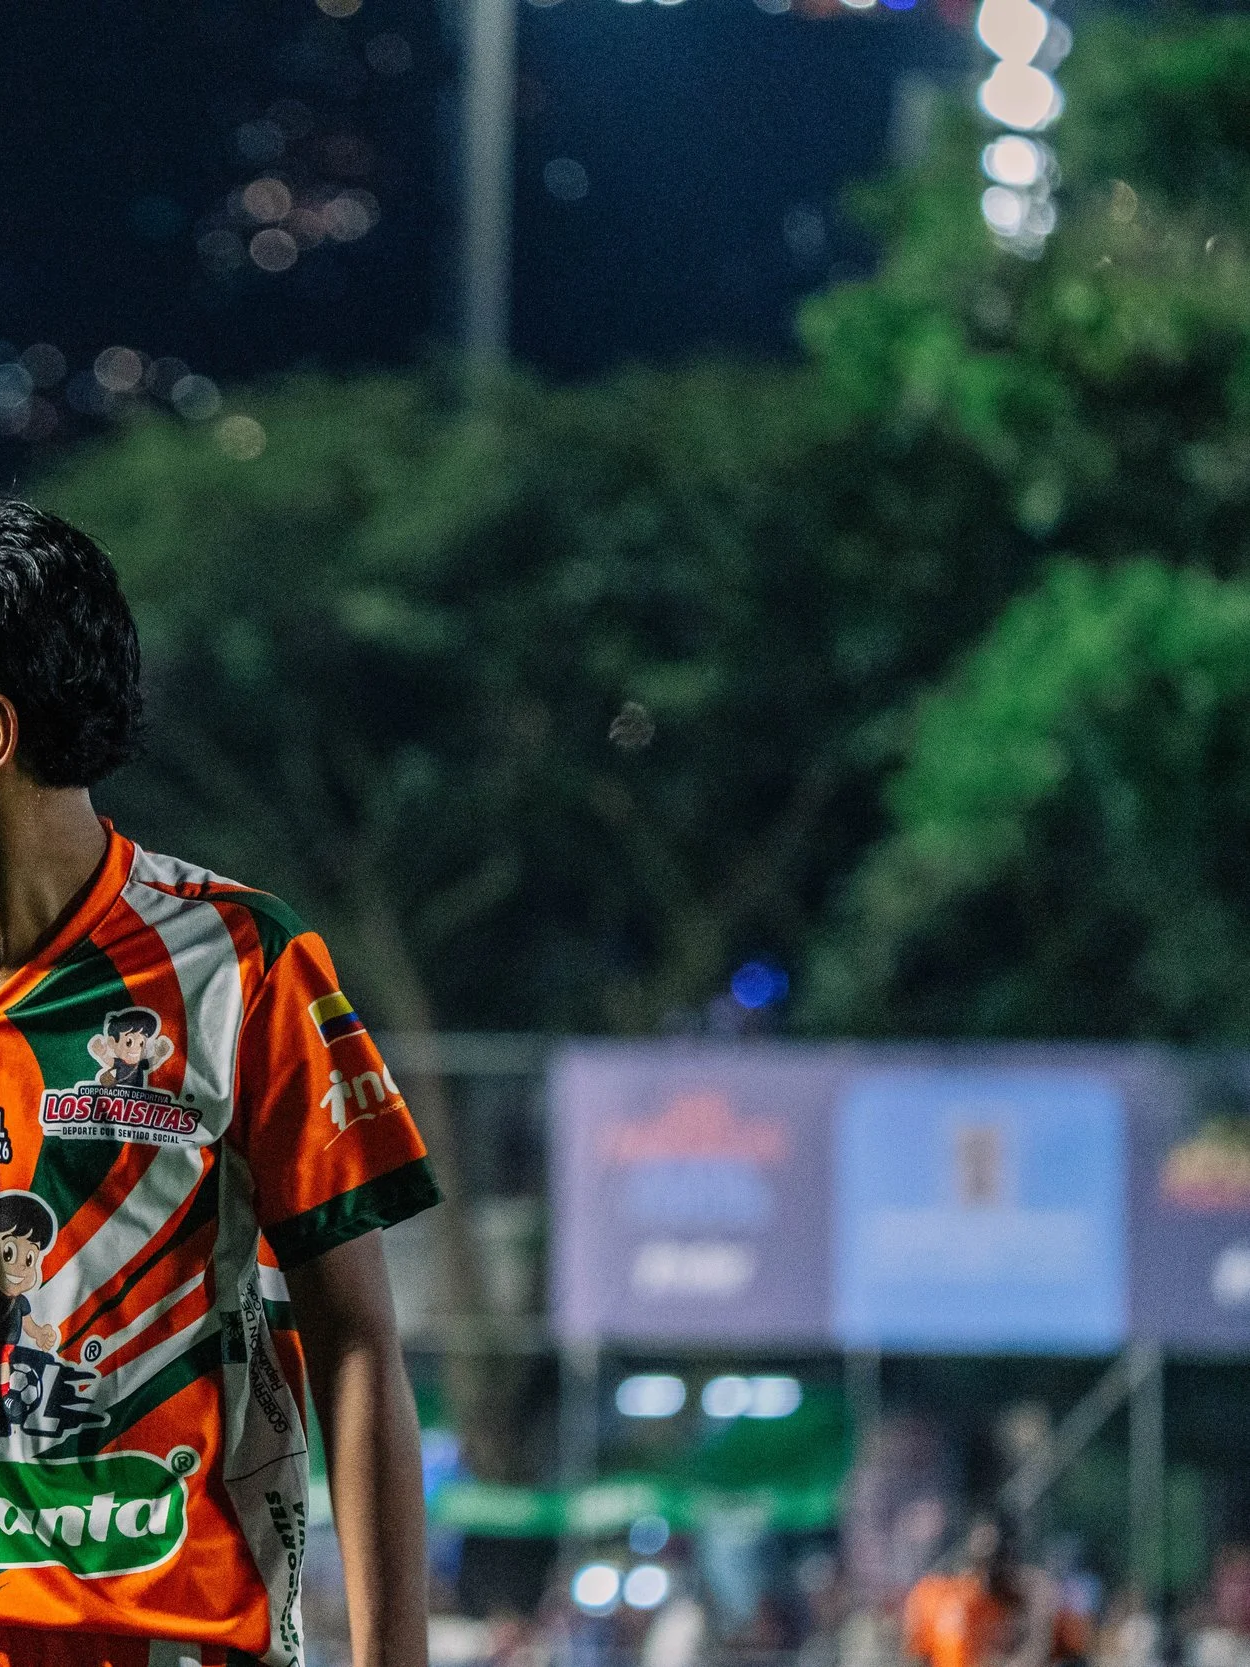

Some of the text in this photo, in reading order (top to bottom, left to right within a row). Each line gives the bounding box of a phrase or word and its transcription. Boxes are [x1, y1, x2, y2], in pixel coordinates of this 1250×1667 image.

[80, 1086, 131, 1099] CORPORACIÓN
[45, 1094, 200, 1134] LOS PAISITAS
[62, 1126, 180, 1145] DEPORTE CON SENTIDO SOCIAL
